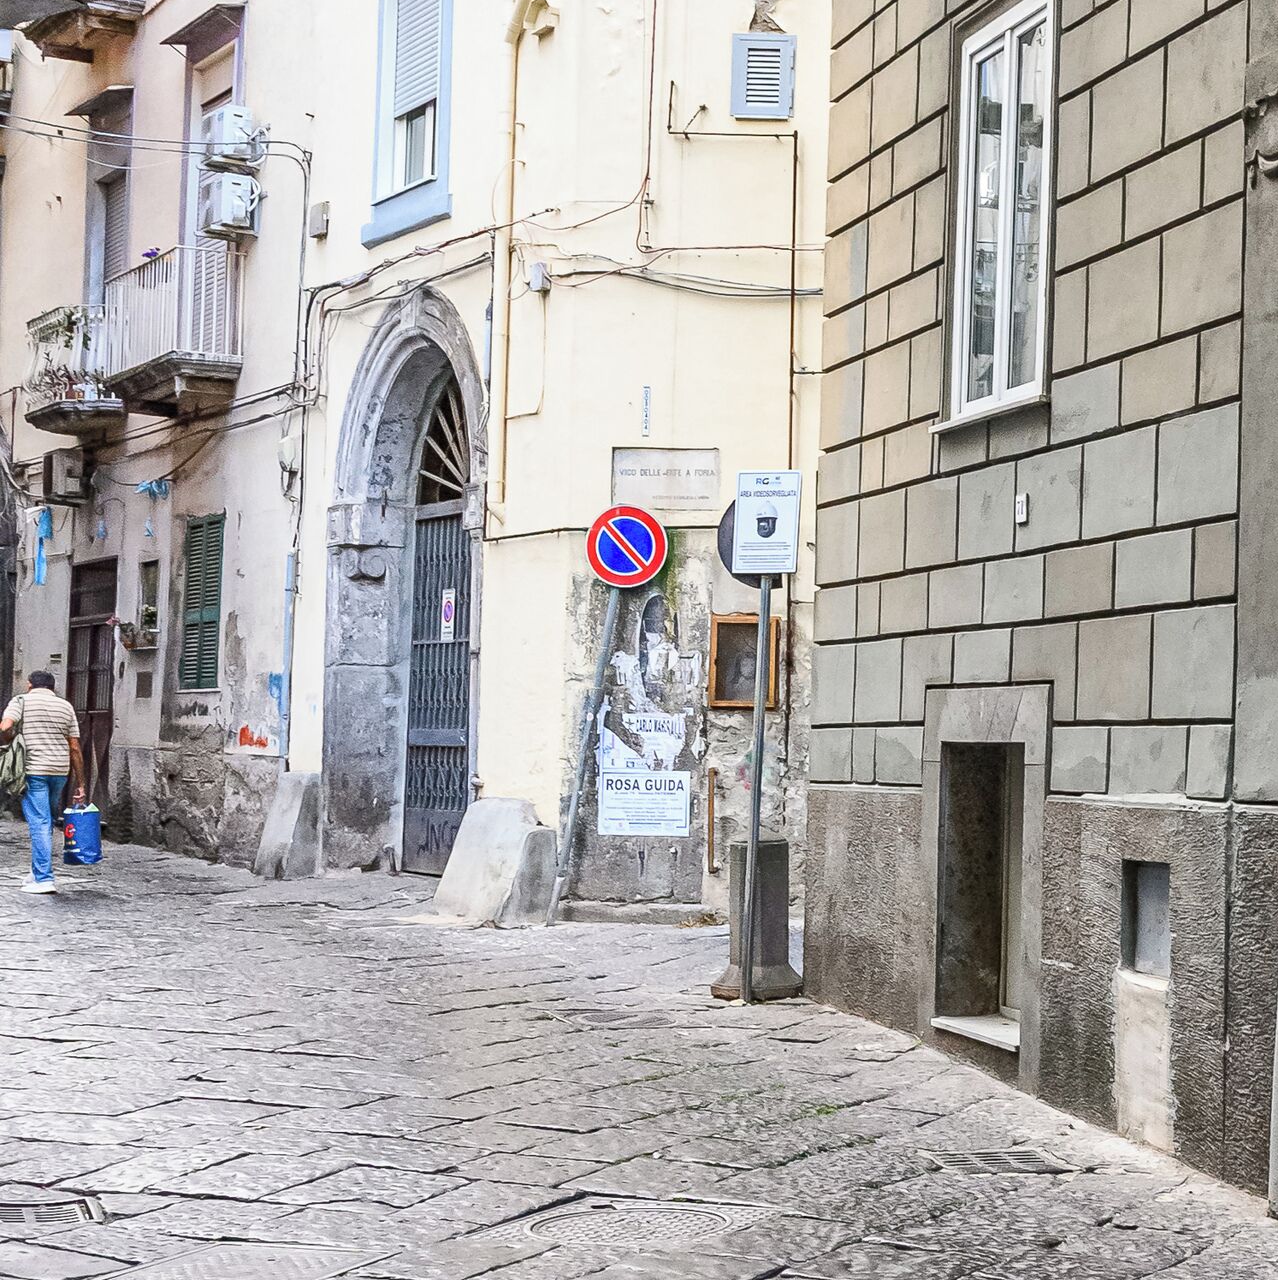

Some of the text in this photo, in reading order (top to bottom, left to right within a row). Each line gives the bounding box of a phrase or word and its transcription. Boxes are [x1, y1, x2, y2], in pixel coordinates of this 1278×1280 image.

[619, 469, 637, 477] VICO
[640, 469, 660, 477] DELLE
[685, 469, 691, 477] A
[694, 469, 717, 477] FORIA
[740, 489, 752, 498] AREA
[606, 779, 685, 791] ROSA GUIDA
